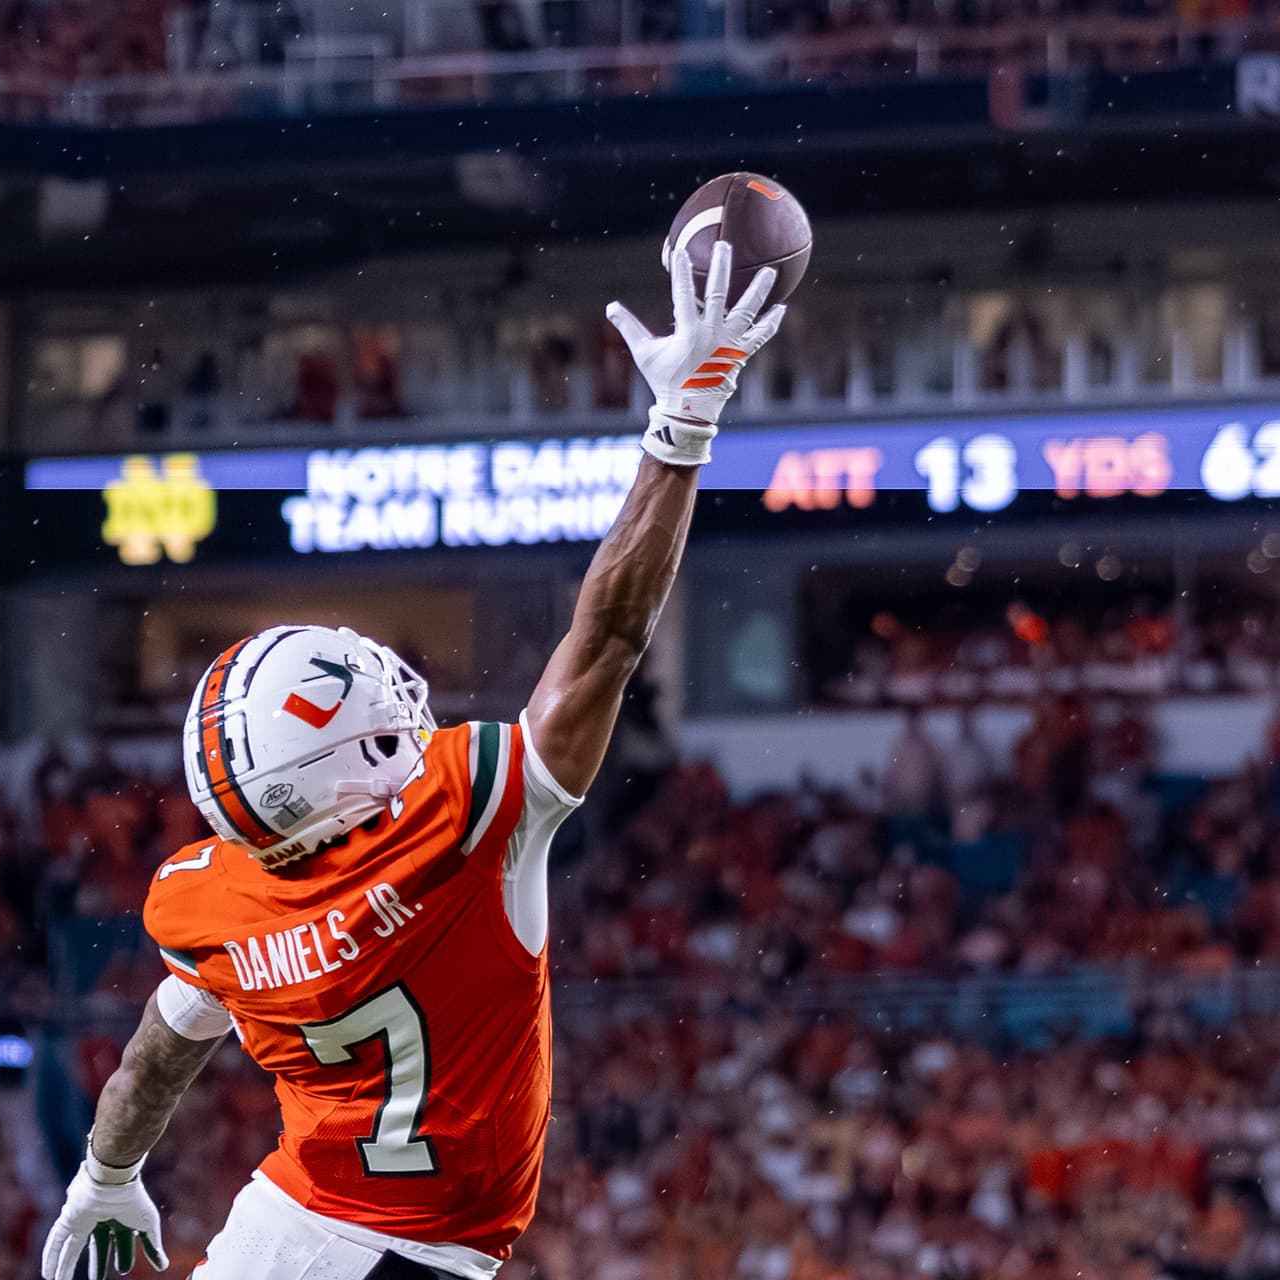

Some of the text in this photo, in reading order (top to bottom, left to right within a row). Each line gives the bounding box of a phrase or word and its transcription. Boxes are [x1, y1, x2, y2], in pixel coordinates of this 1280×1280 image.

[307, 445, 488, 500] NOTRE
[763, 432, 1174, 512] ATT 13 YDS
[282, 492, 625, 553] TEAM RUSHIN
[265, 783, 289, 806] ACC
[261, 841, 307, 867] MIAMI
[223, 882, 424, 992] DANIELS JR.
[298, 978, 440, 1177] 7
